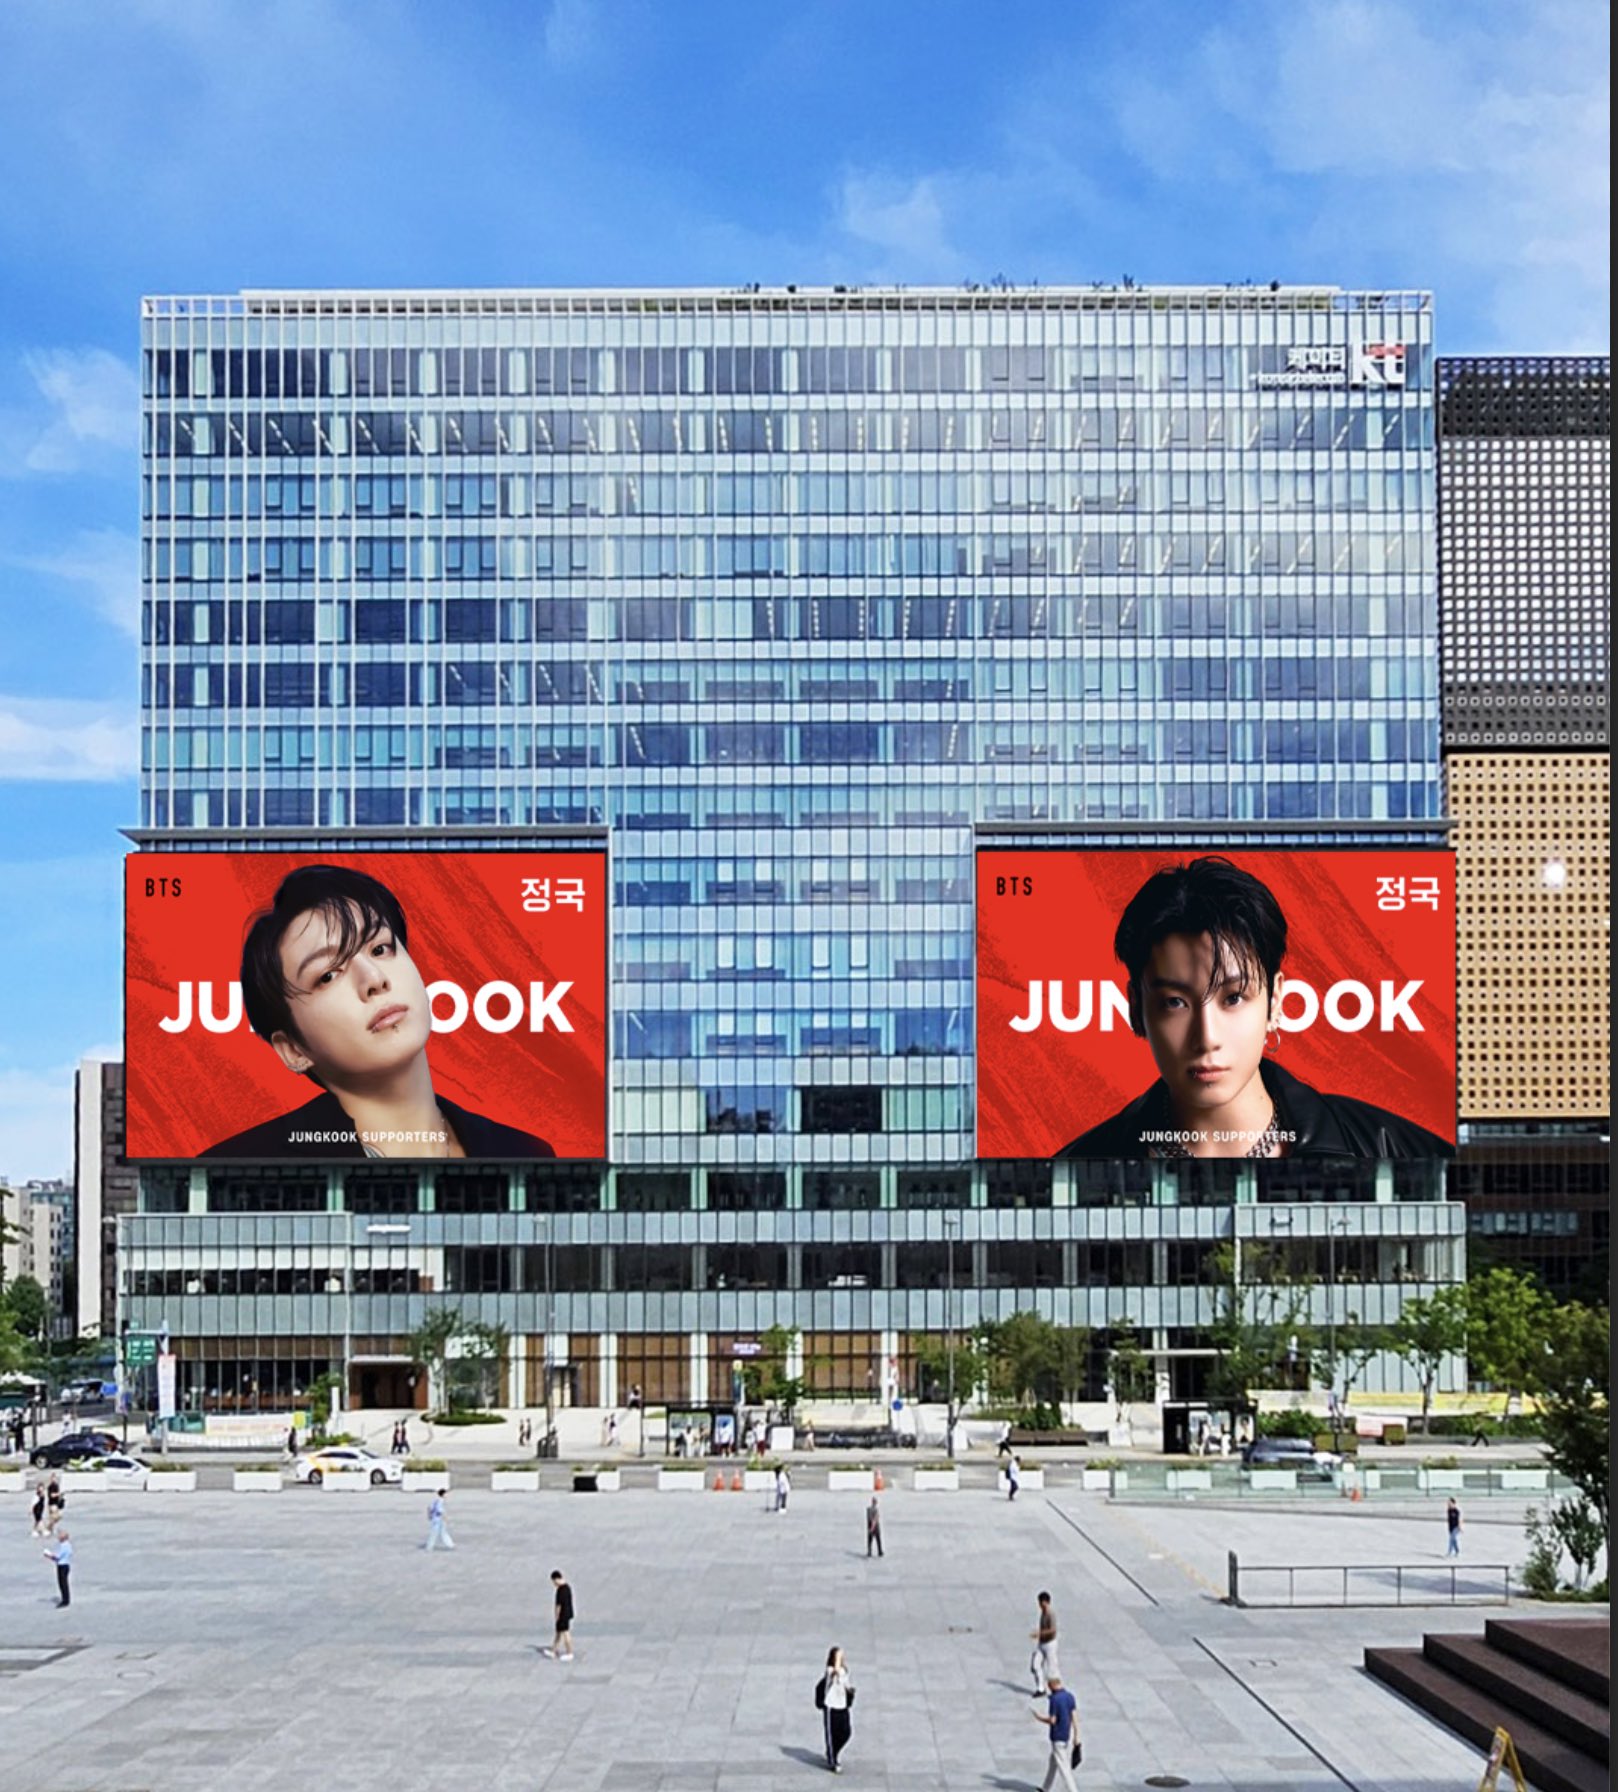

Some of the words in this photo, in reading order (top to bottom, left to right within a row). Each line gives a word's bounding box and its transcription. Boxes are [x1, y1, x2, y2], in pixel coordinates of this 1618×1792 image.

[1351, 339, 1407, 384] kt
[145, 877, 182, 897] BTS
[521, 878, 586, 913] 정국
[996, 876, 1033, 896] BTS
[1376, 876, 1441, 911] 정국
[158, 981, 575, 1034] JUOOK
[1008, 980, 1425, 1033] JUNOOK
[288, 1131, 358, 1143] JUNGKOOK
[362, 1131, 446, 1143] SUPPORTERS
[1139, 1131, 1208, 1143] JUNGKOOK
[1213, 1131, 1297, 1143] SUPPORTERS
